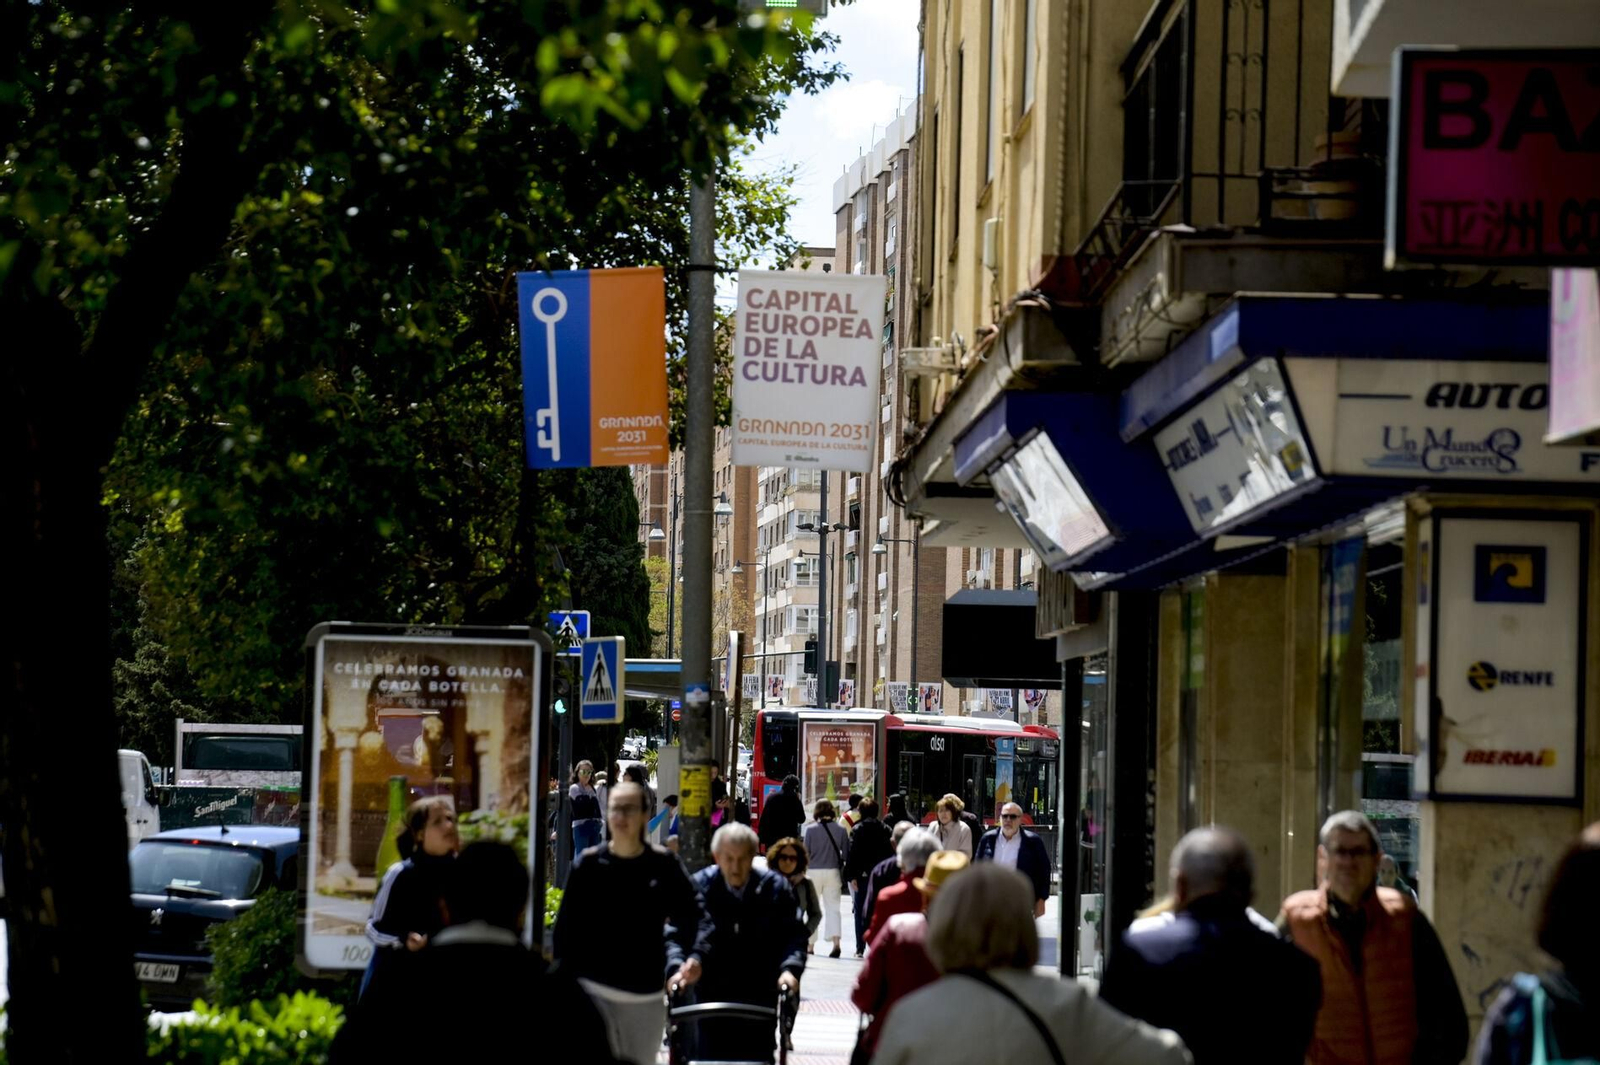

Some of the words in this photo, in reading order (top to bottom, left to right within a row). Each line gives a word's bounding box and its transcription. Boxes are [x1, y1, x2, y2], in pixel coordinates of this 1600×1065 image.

[1424, 68, 1600, 150] BA
[745, 288, 858, 315] CAPITAL
[745, 312, 874, 339] EUROPEA
[743, 336, 780, 359] DE
[785, 338, 819, 361] LA
[742, 361, 867, 387] CULTURA
[599, 415, 663, 429] GRANADA
[737, 417, 826, 437] GRANADA
[829, 423, 871, 441] 2031
[617, 430, 647, 443] 2031
[737, 437, 770, 446] CAPITAL
[770, 439, 807, 448] EUROPEA
[809, 441, 819, 449] DE
[832, 442, 869, 452] CULTURA
[1383, 425, 1417, 452] Un
[333, 662, 440, 678] CELEBRAMOS
[446, 665, 525, 679] GRANADA
[1500, 671, 1554, 686] RENFE
[350, 678, 371, 690] EN
[378, 679, 422, 692] CADA
[930, 734, 945, 752] alsa
[1463, 749, 1535, 766] IBERIA
[341, 945, 372, 962] 100
